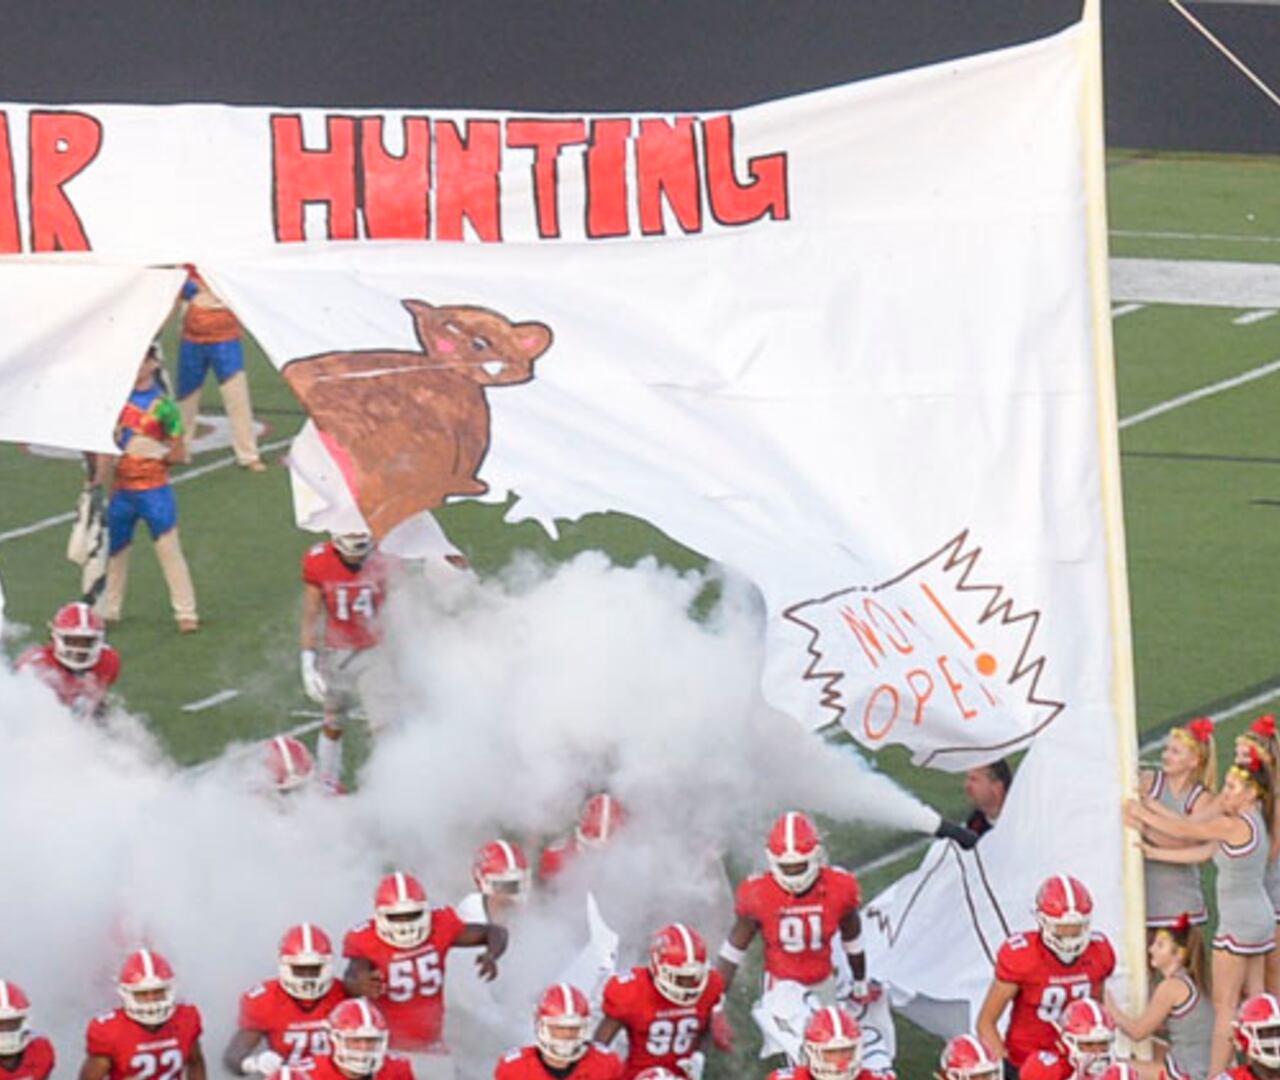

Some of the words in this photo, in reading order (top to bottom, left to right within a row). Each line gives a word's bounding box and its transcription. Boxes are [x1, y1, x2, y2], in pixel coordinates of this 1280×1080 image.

[271, 109, 790, 243] HUNTING
[336, 588, 373, 621] 14
[780, 915, 823, 953] 91
[388, 953, 443, 1002] 55
